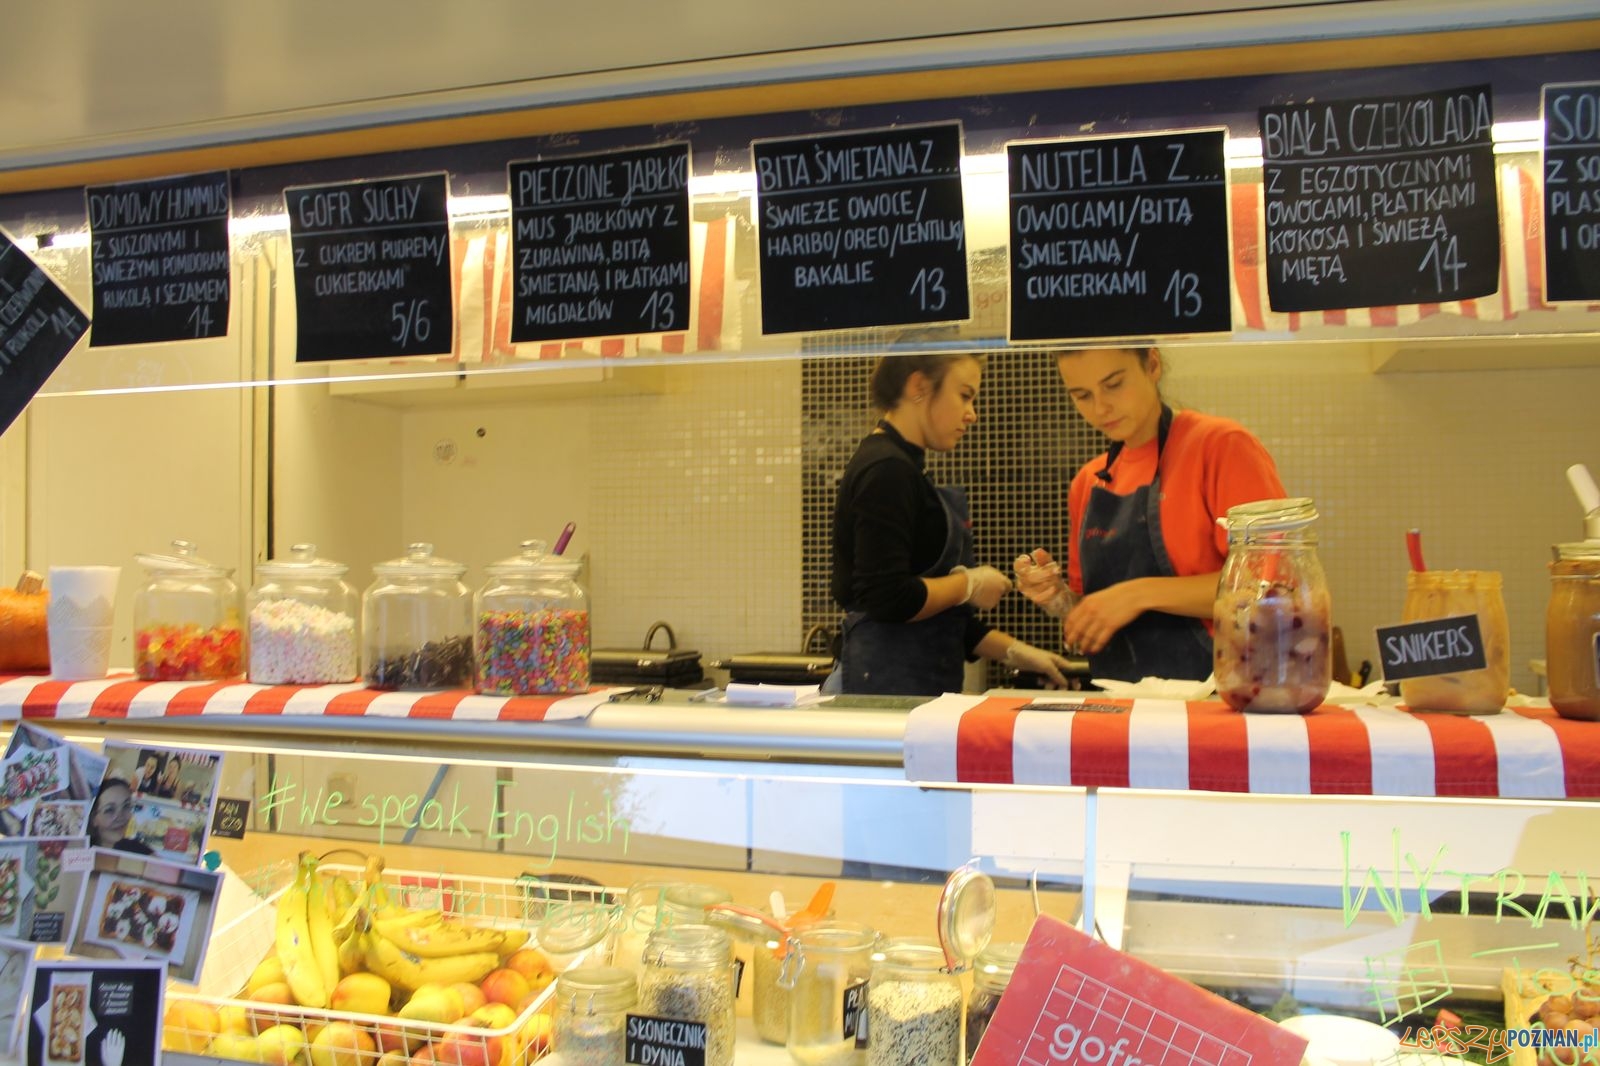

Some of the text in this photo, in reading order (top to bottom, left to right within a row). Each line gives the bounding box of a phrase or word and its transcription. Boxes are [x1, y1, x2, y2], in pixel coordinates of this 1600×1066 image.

[1264, 92, 1492, 159] BIAŁA CZEKOLADA
[518, 163, 615, 207] PIECZONE
[758, 153, 811, 192] BITA
[814, 142, 918, 185] ŚMIETANA
[1021, 144, 1148, 192] NUTELLA
[1267, 168, 1286, 195] Z
[1546, 159, 1568, 184] Z
[90, 182, 229, 230] DOMOWY HUMMUS
[300, 184, 422, 228] GOFR SUCHY
[1266, 182, 1477, 227] OWOCAMI, PŁATKAMI
[517, 204, 679, 245] MUS JABŁKOWY Z
[1357, 223, 1364, 249] I
[1560, 226, 1568, 251] I
[92, 229, 200, 260] Z SUSZONYMI I
[294, 247, 309, 268] Z
[319, 240, 376, 266] CUKREM
[314, 267, 406, 297] CUKIERKAMI
[518, 261, 688, 297] ŚMIETANĄ I PŁATKAMI
[794, 260, 875, 289] BAKALIE
[1281, 254, 1348, 287] MIĘTĄ
[1418, 235, 1468, 294] 14
[162, 278, 229, 306] SEZAMEM
[909, 267, 947, 312] 13
[1026, 270, 1148, 300] CUKIERKAMI
[1163, 269, 1203, 318] 13
[185, 303, 214, 338] 14
[391, 298, 431, 348] 5/6
[525, 296, 614, 327] MIGDAŁÓW
[639, 290, 675, 330] 13
[1385, 624, 1475, 667] SNIKERS
[358, 781, 472, 848] speak
[488, 776, 631, 870] English
[627, 1016, 706, 1050] SŁONECZNIK
[630, 1042, 686, 1066] I DYNIA
